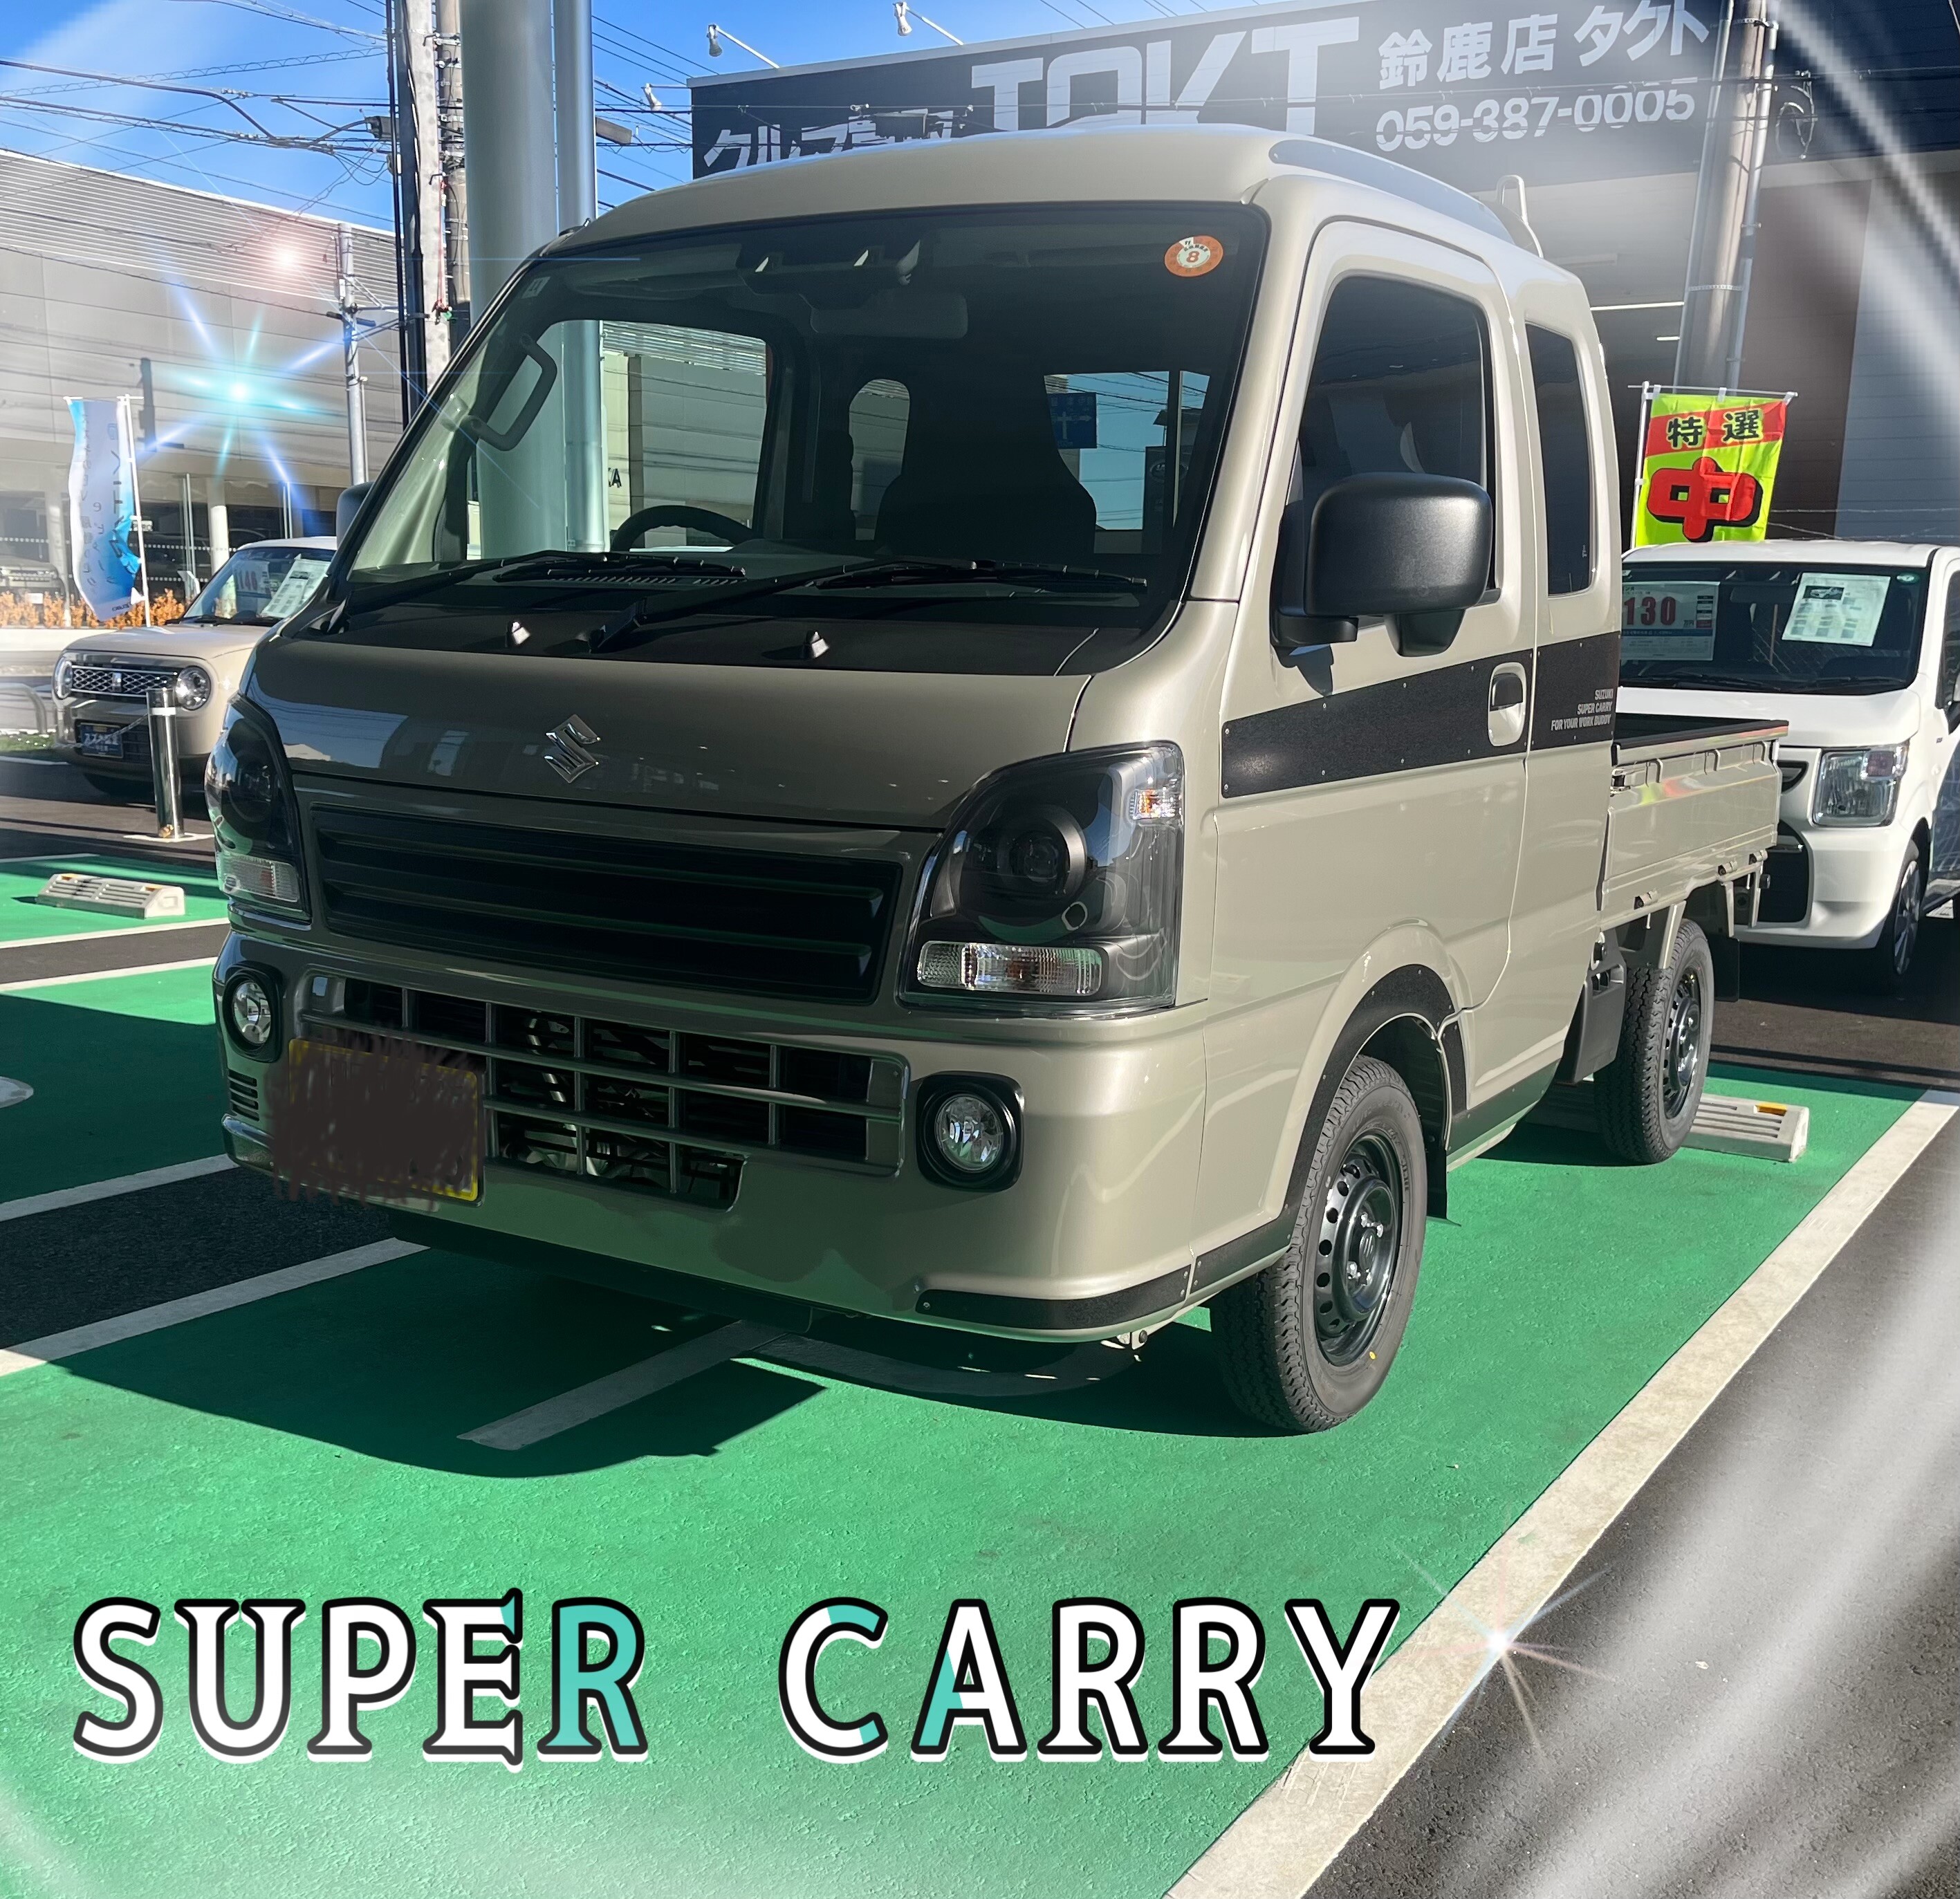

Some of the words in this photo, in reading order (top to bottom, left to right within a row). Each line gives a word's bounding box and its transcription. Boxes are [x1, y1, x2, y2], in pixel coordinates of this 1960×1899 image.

[1378, 14, 1558, 90] 鈴鹿店
[1574, 0, 1710, 67] タクト
[1375, 77, 1699, 152] 059-387-0005
[1186, 251, 1200, 263] 8
[1667, 409, 1763, 450] 特選
[1647, 456, 1764, 542] 中
[1624, 596, 1676, 626] 130
[1577, 703, 1595, 714] SUPER
[1596, 701, 1613, 713] CARRY
[1595, 689, 1614, 700] SUZUKI
[1551, 719, 1563, 731] FOR
[1564, 717, 1578, 730] YOUR
[1579, 716, 1593, 728] WORK
[1594, 714, 1611, 725] BUDDY
